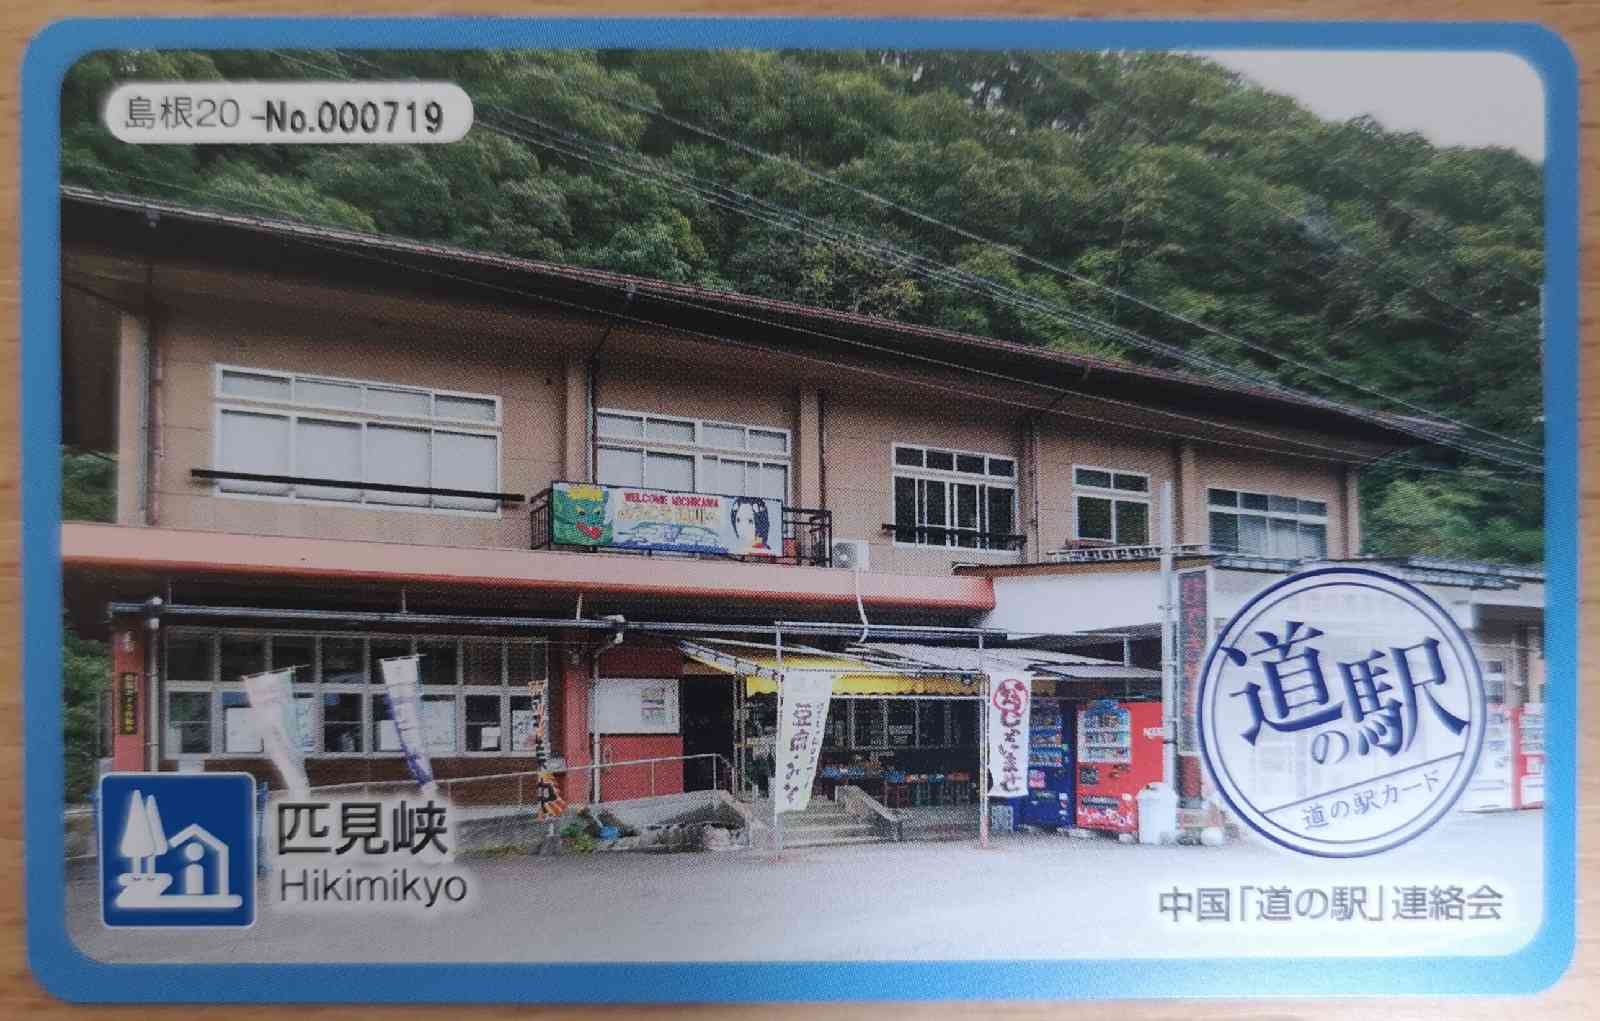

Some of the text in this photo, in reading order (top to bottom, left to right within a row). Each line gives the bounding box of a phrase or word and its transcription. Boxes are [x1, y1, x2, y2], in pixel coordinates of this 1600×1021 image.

[125, 97, 444, 134] 島根20 -No.000719
[623, 492, 668, 504] WELCOME
[1219, 621, 1471, 765] 道の駅
[1301, 772, 1441, 831] 道の駅カード
[278, 801, 449, 856] 匹見峡
[280, 868, 467, 907] Hikimikyo
[1158, 885, 1504, 923] 中国「道の駅」連絡会
